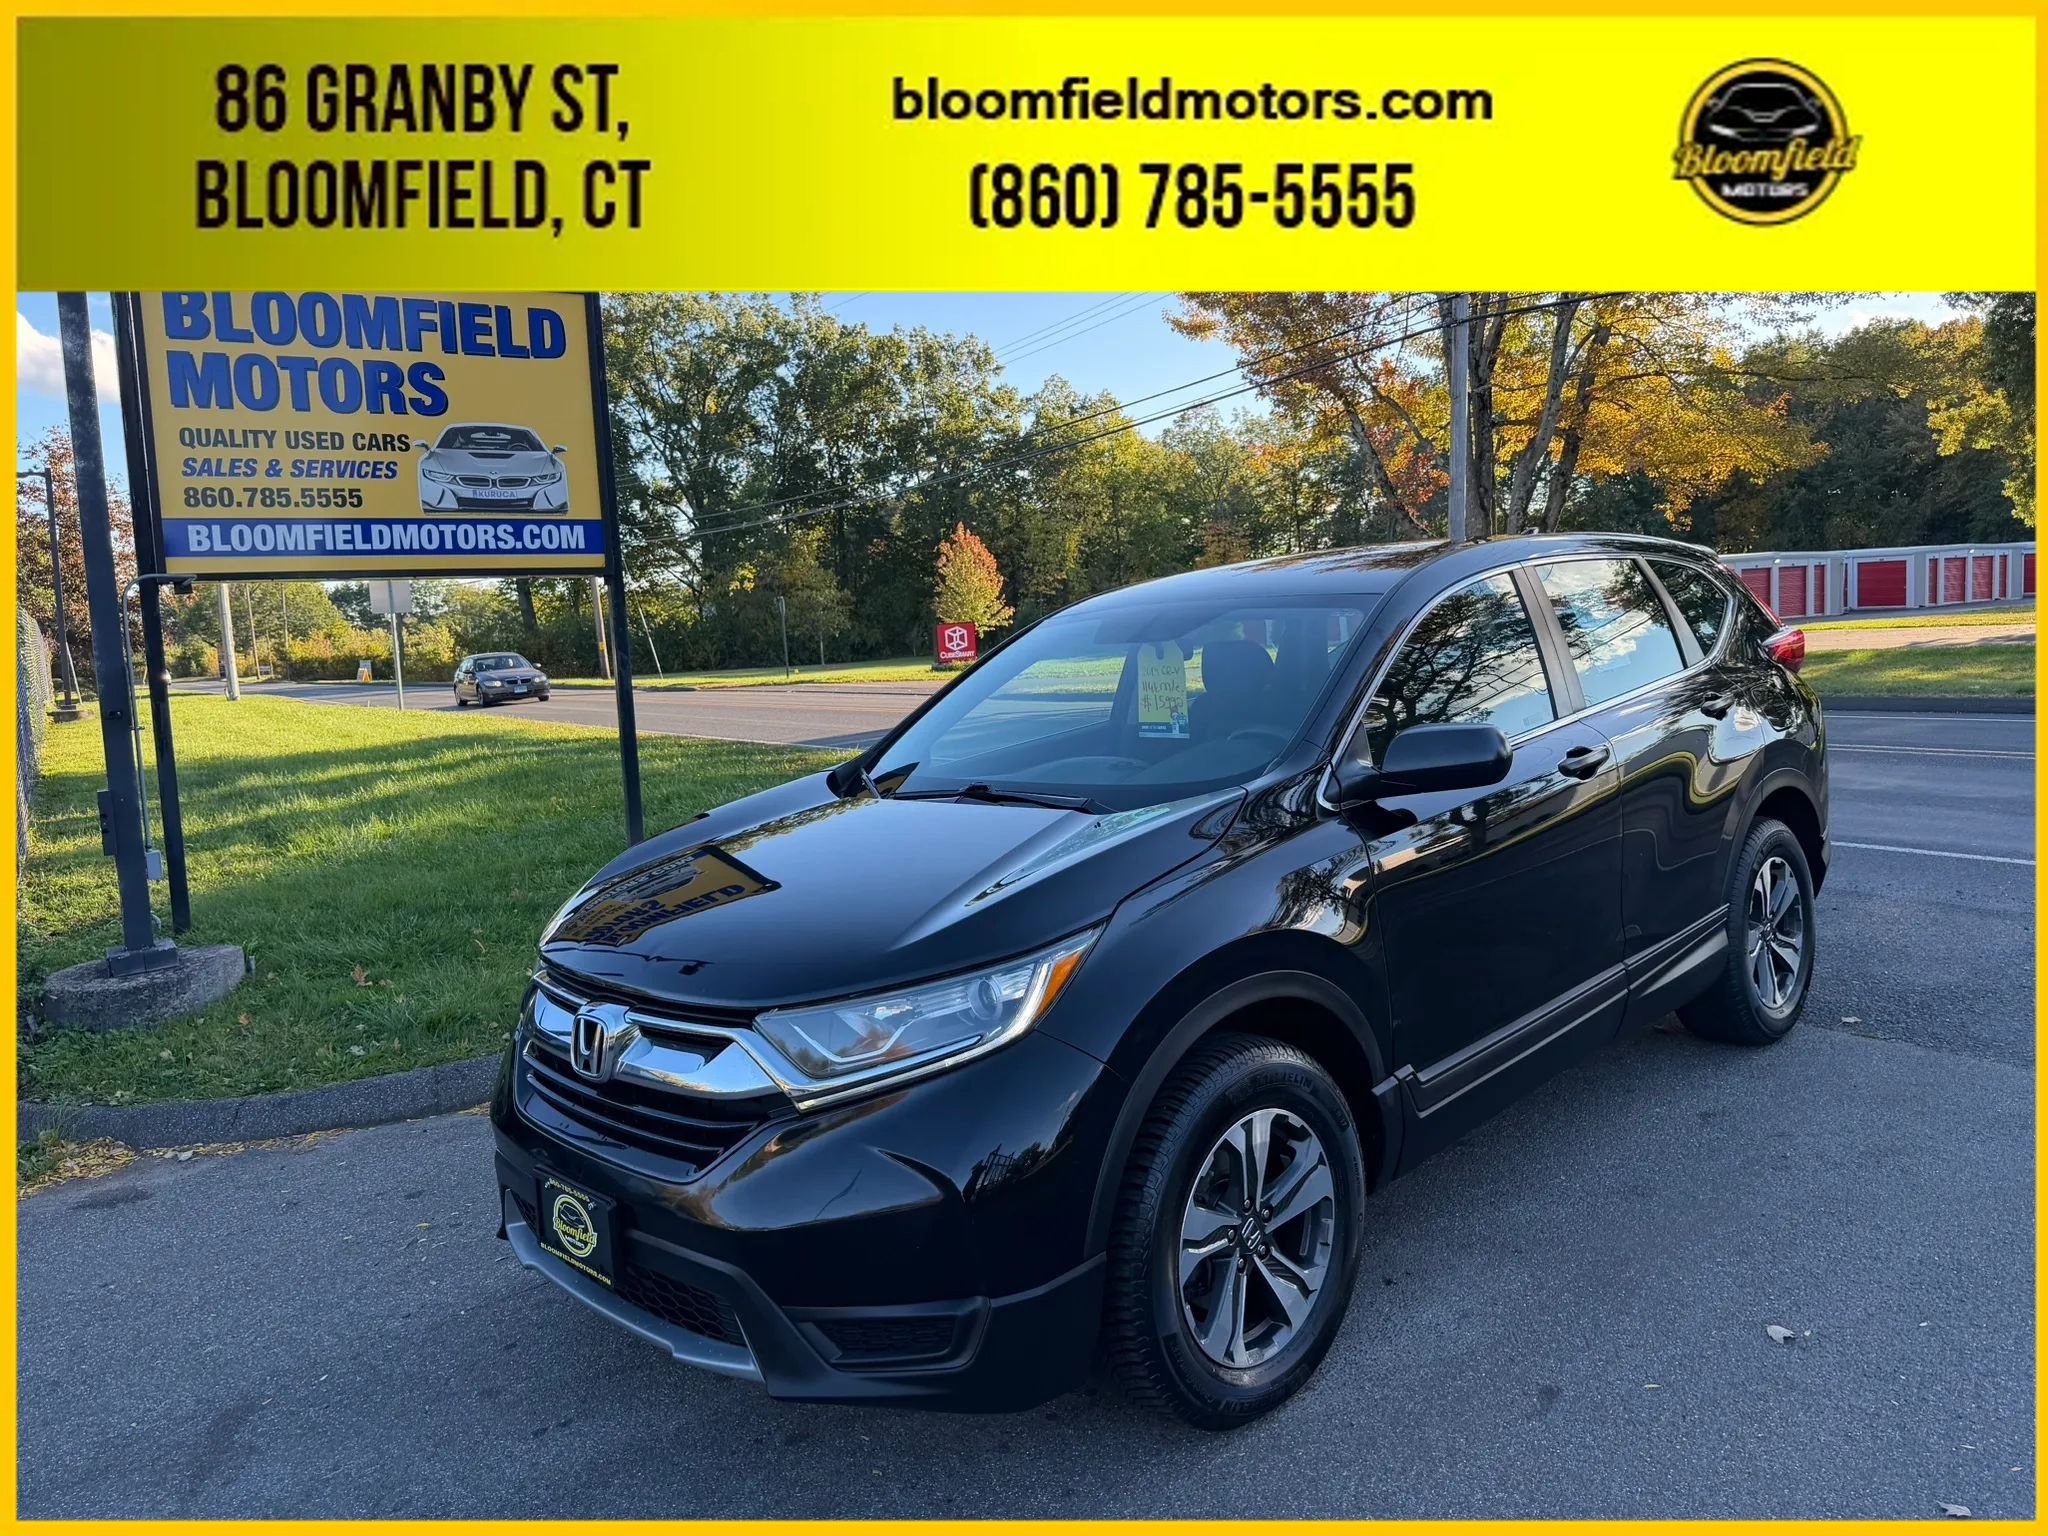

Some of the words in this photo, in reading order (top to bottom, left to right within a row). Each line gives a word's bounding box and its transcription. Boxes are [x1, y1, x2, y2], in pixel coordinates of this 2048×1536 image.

[163, 292, 566, 360] BLOOMFIELD
[166, 349, 449, 417] MOTORS
[179, 427, 278, 450] QUALITY
[285, 430, 345, 451] USED
[352, 432, 411, 452] CARS
[181, 457, 258, 478] SALES
[264, 458, 283, 478] &
[289, 459, 399, 480] SERVICES
[183, 486, 364, 508] 860.785.5555
[187, 524, 586, 553] BLOOMFIELDMOTORS.COM
[555, 1217, 596, 1246] Bloomfield
[540, 1242, 612, 1286] BLOOMFIELDMOTORS.COM
